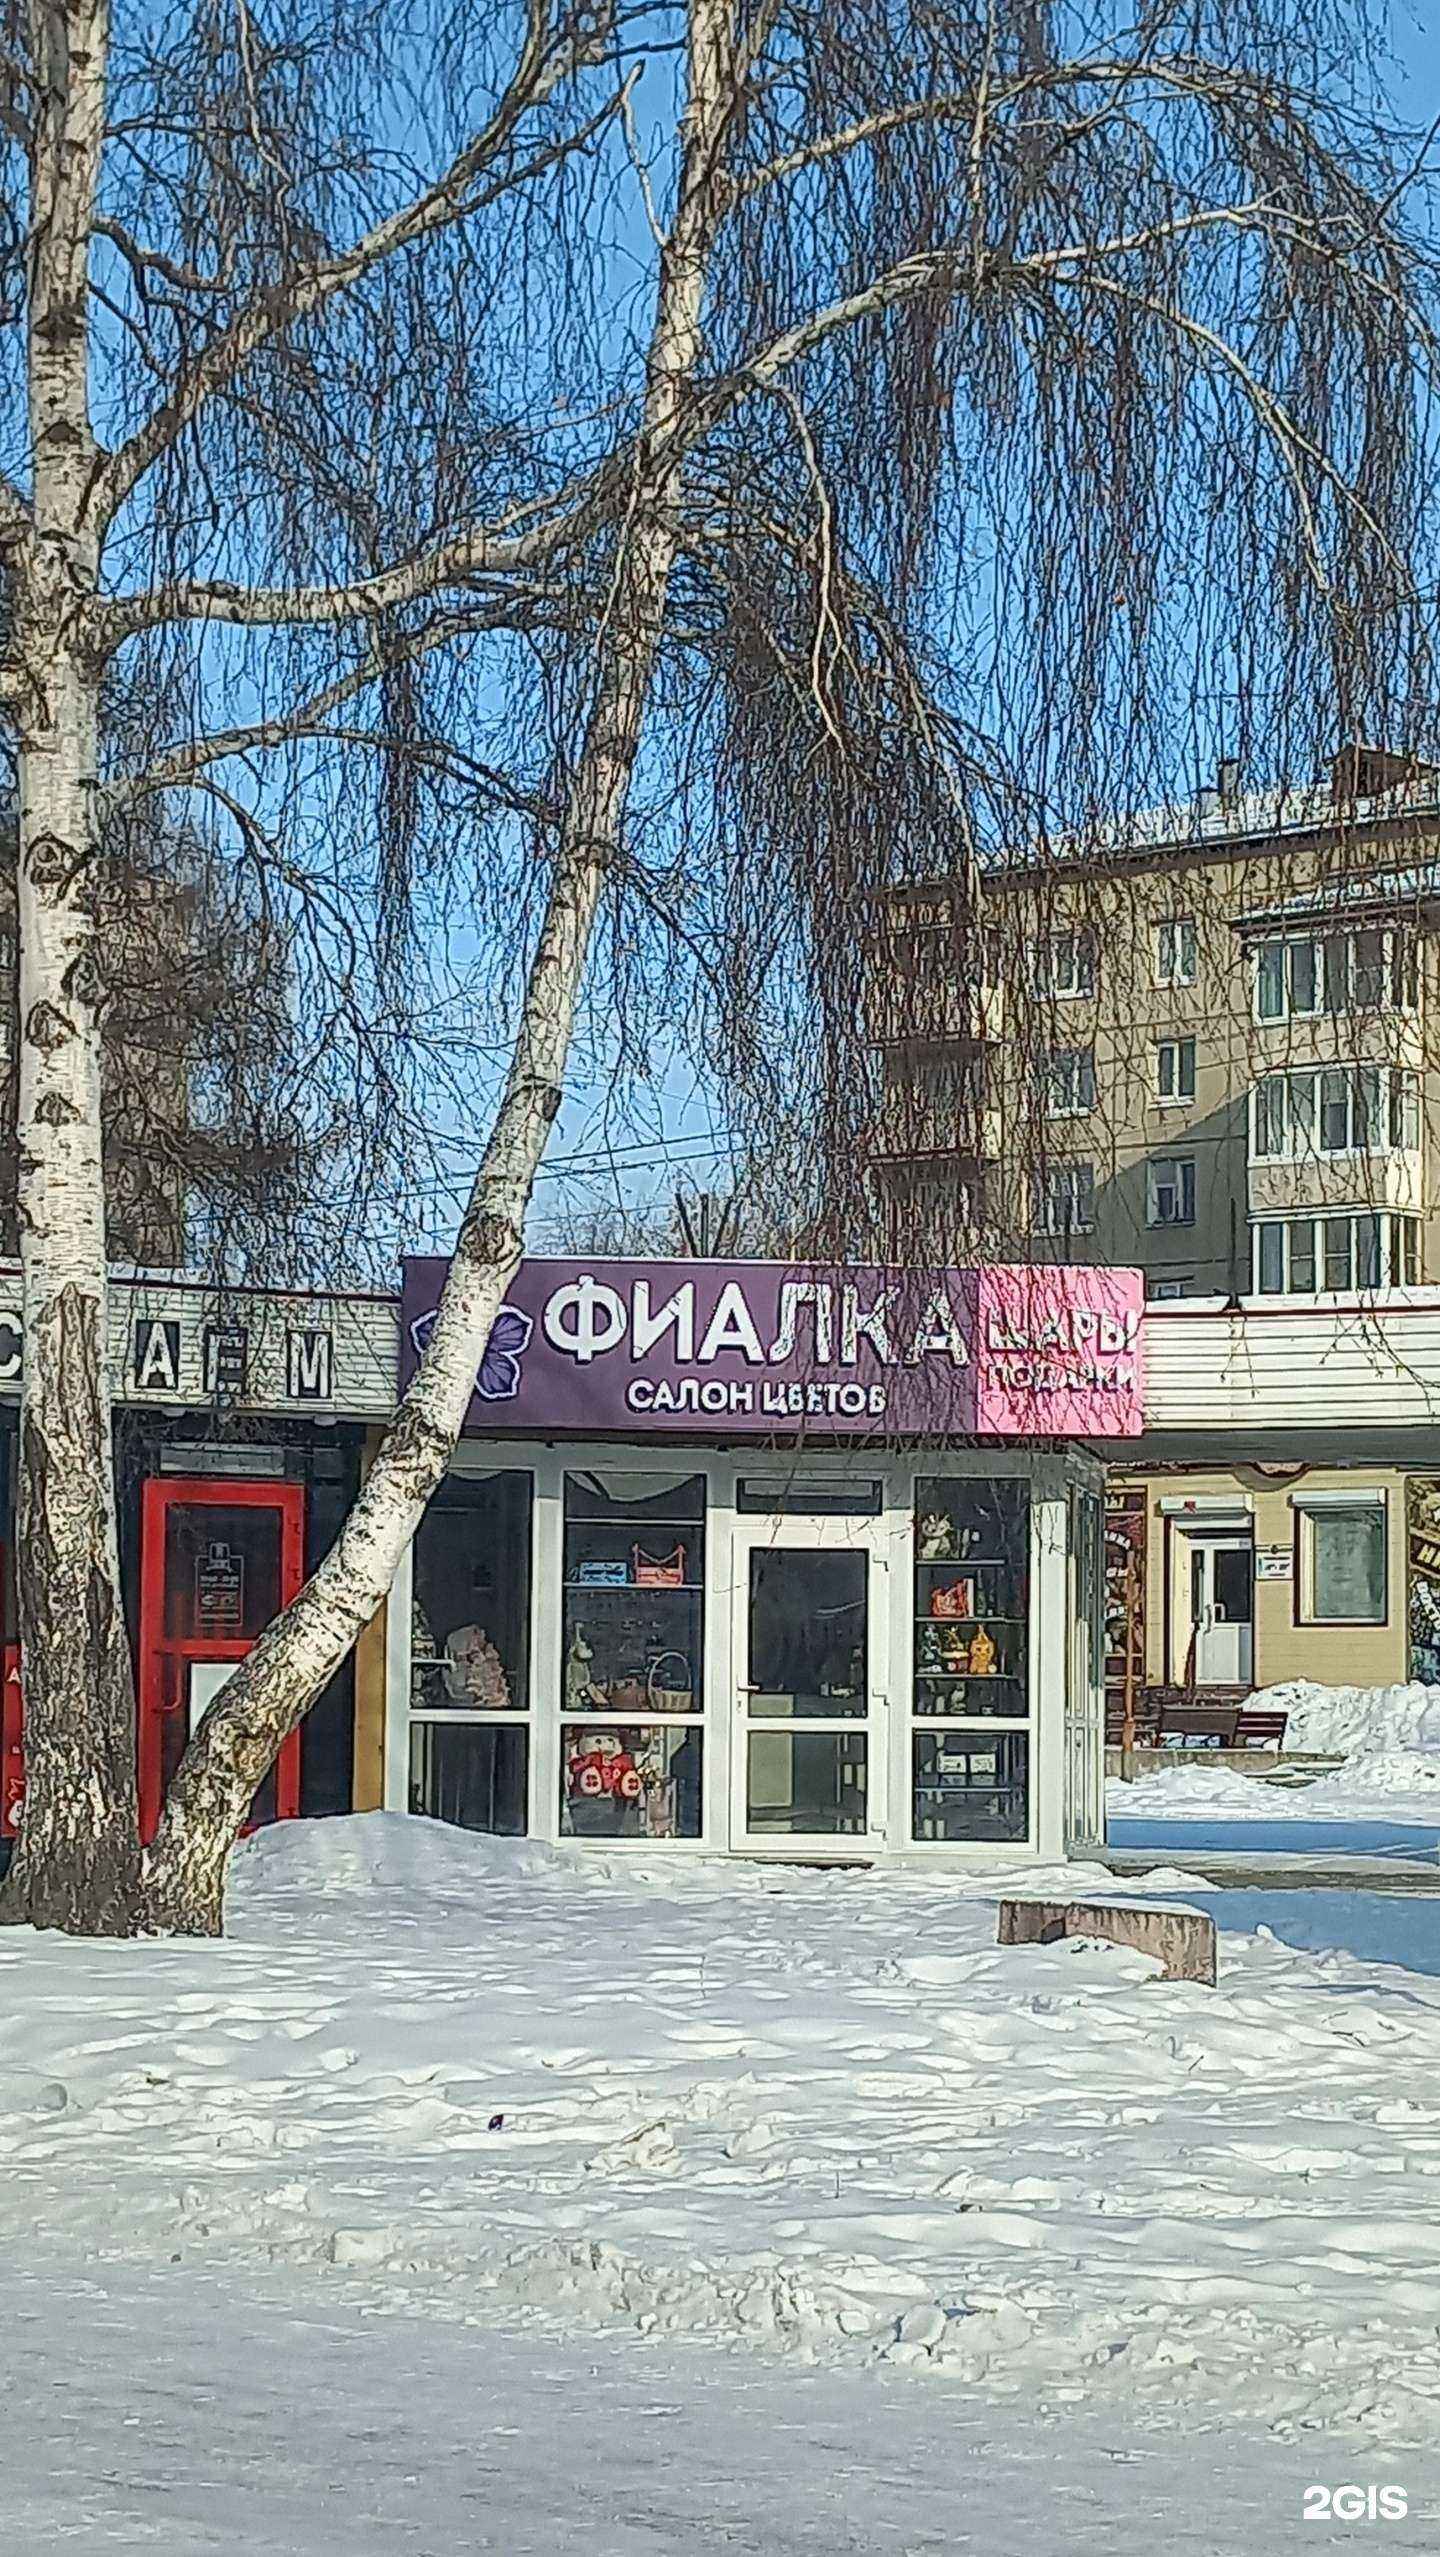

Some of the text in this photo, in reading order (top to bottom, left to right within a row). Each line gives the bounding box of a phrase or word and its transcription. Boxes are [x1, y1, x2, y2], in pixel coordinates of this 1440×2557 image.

[0, 1310, 329, 1399] САЕМ
[543, 1272, 970, 1366] ФИАЛКА
[626, 1378, 888, 1416] САЛОН ЦВЕТОВ
